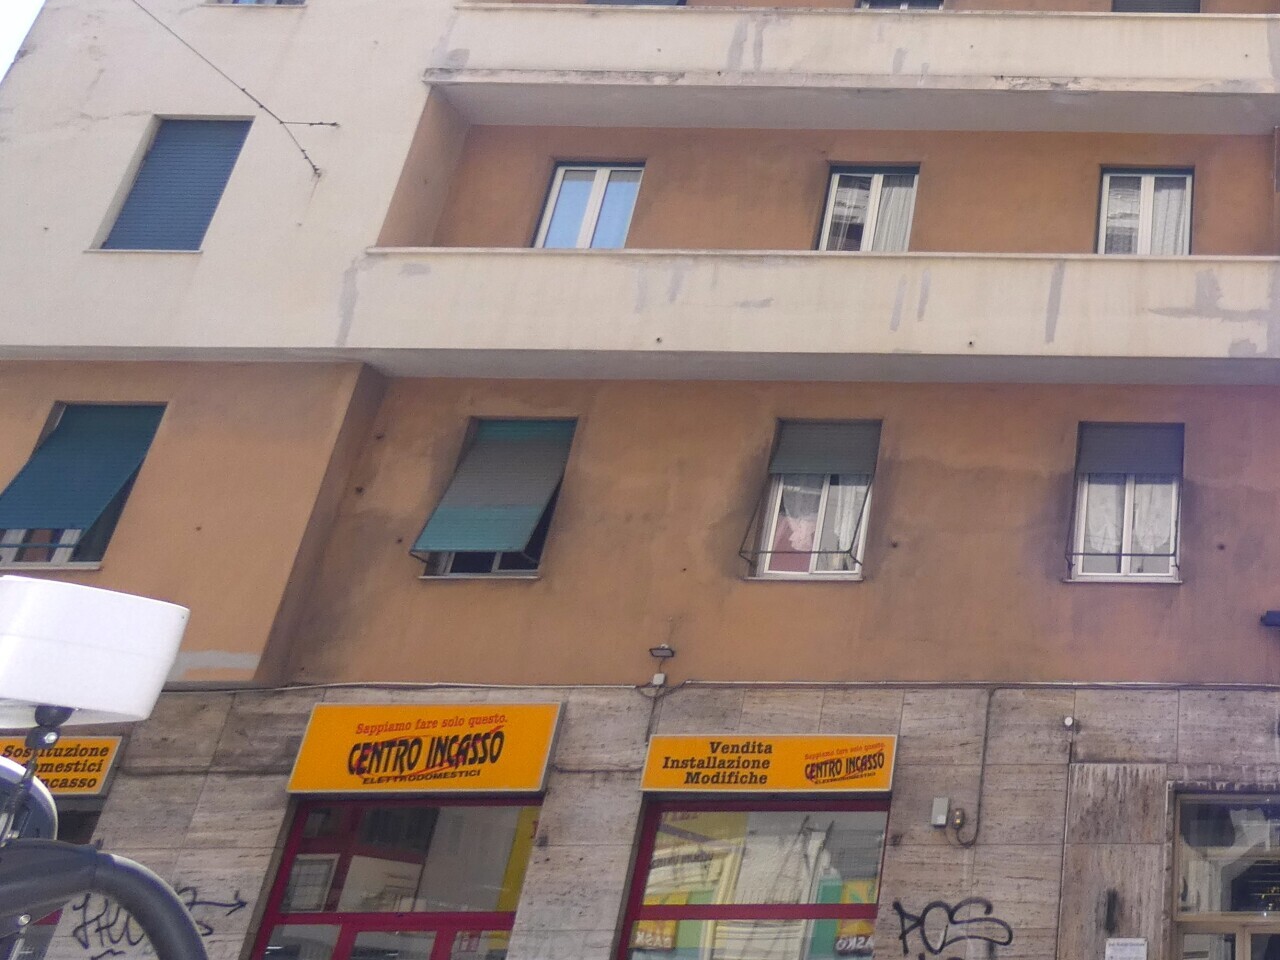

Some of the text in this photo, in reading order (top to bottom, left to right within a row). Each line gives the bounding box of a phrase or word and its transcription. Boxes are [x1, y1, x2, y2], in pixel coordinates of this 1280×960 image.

[355, 713, 508, 735] Sappiamo fare solo questo.
[2, 744, 109, 758] Sosituzione
[348, 730, 505, 775] CENTRO INCASSO
[709, 741, 773, 754] Vendita
[662, 756, 770, 769] Installazione
[804, 752, 885, 780] CENTRO INCASSO
[362, 769, 481, 785] ELETTRODOMESTICI
[684, 771, 768, 784] Modifiche
